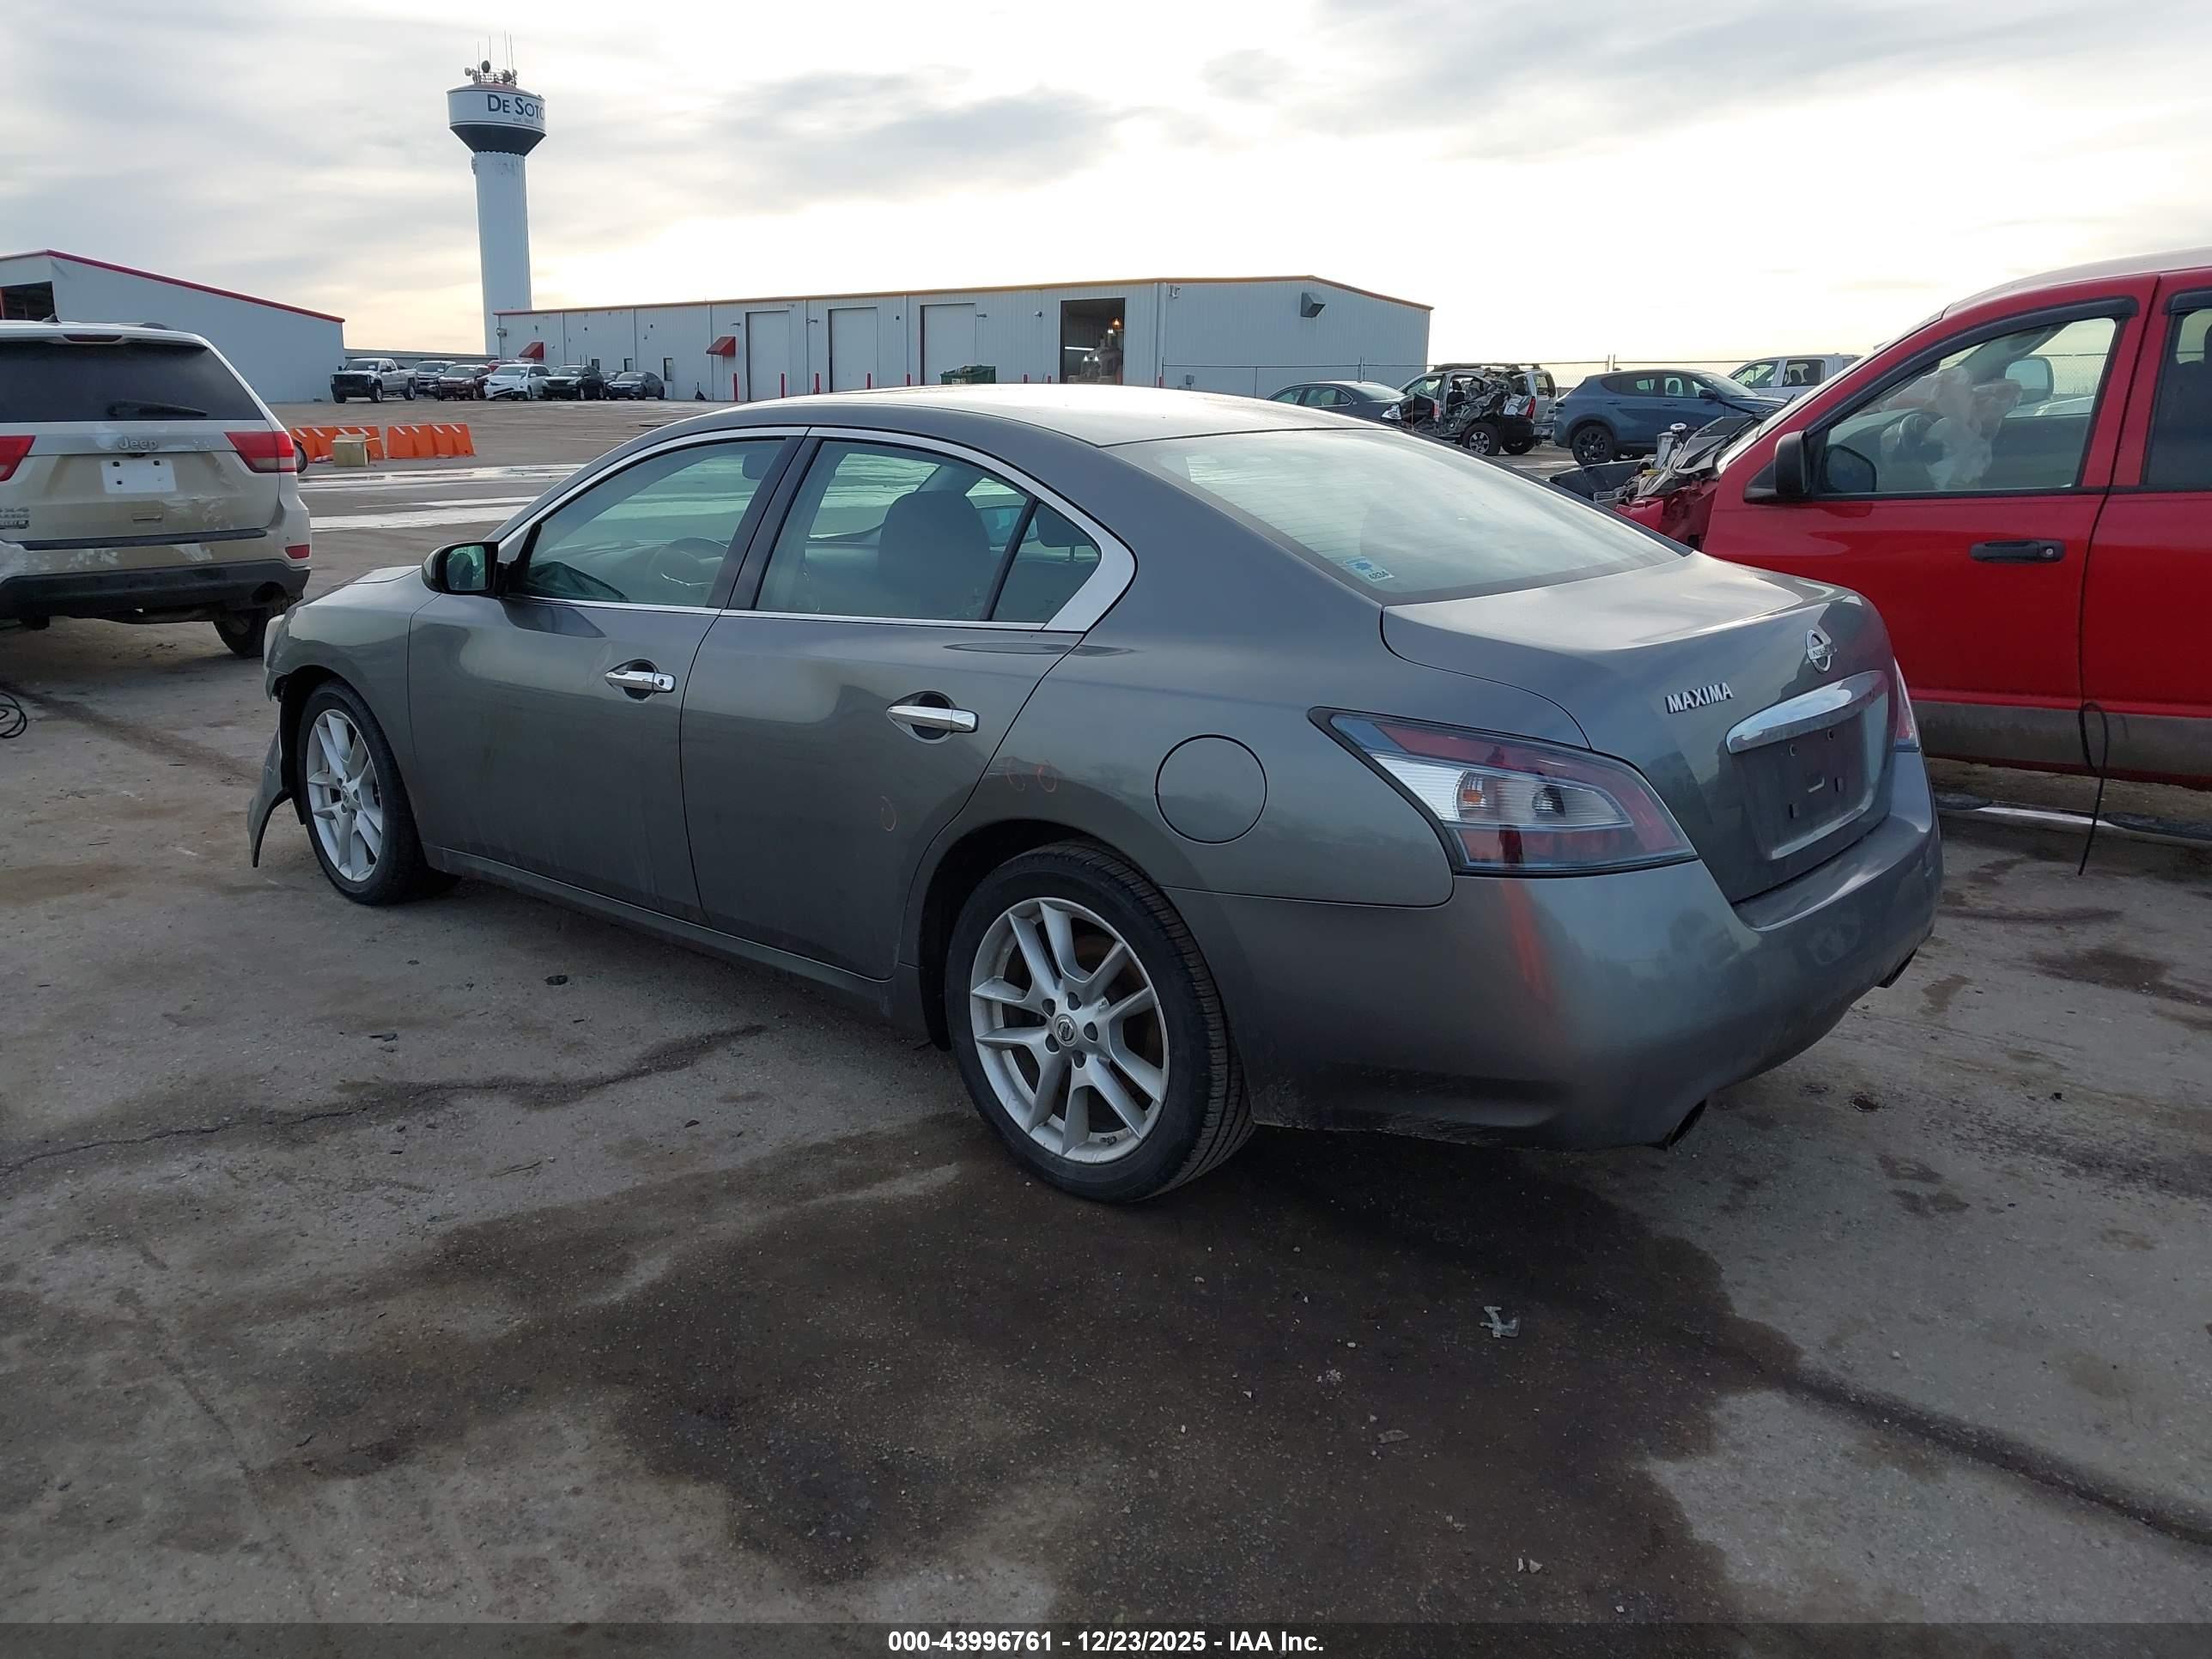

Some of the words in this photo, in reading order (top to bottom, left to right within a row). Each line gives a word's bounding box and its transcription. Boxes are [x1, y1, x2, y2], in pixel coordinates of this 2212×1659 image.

[486, 94, 510, 113] DE
[118, 433, 158, 451] Jeep
[1665, 682, 1734, 714] MAXIMA
